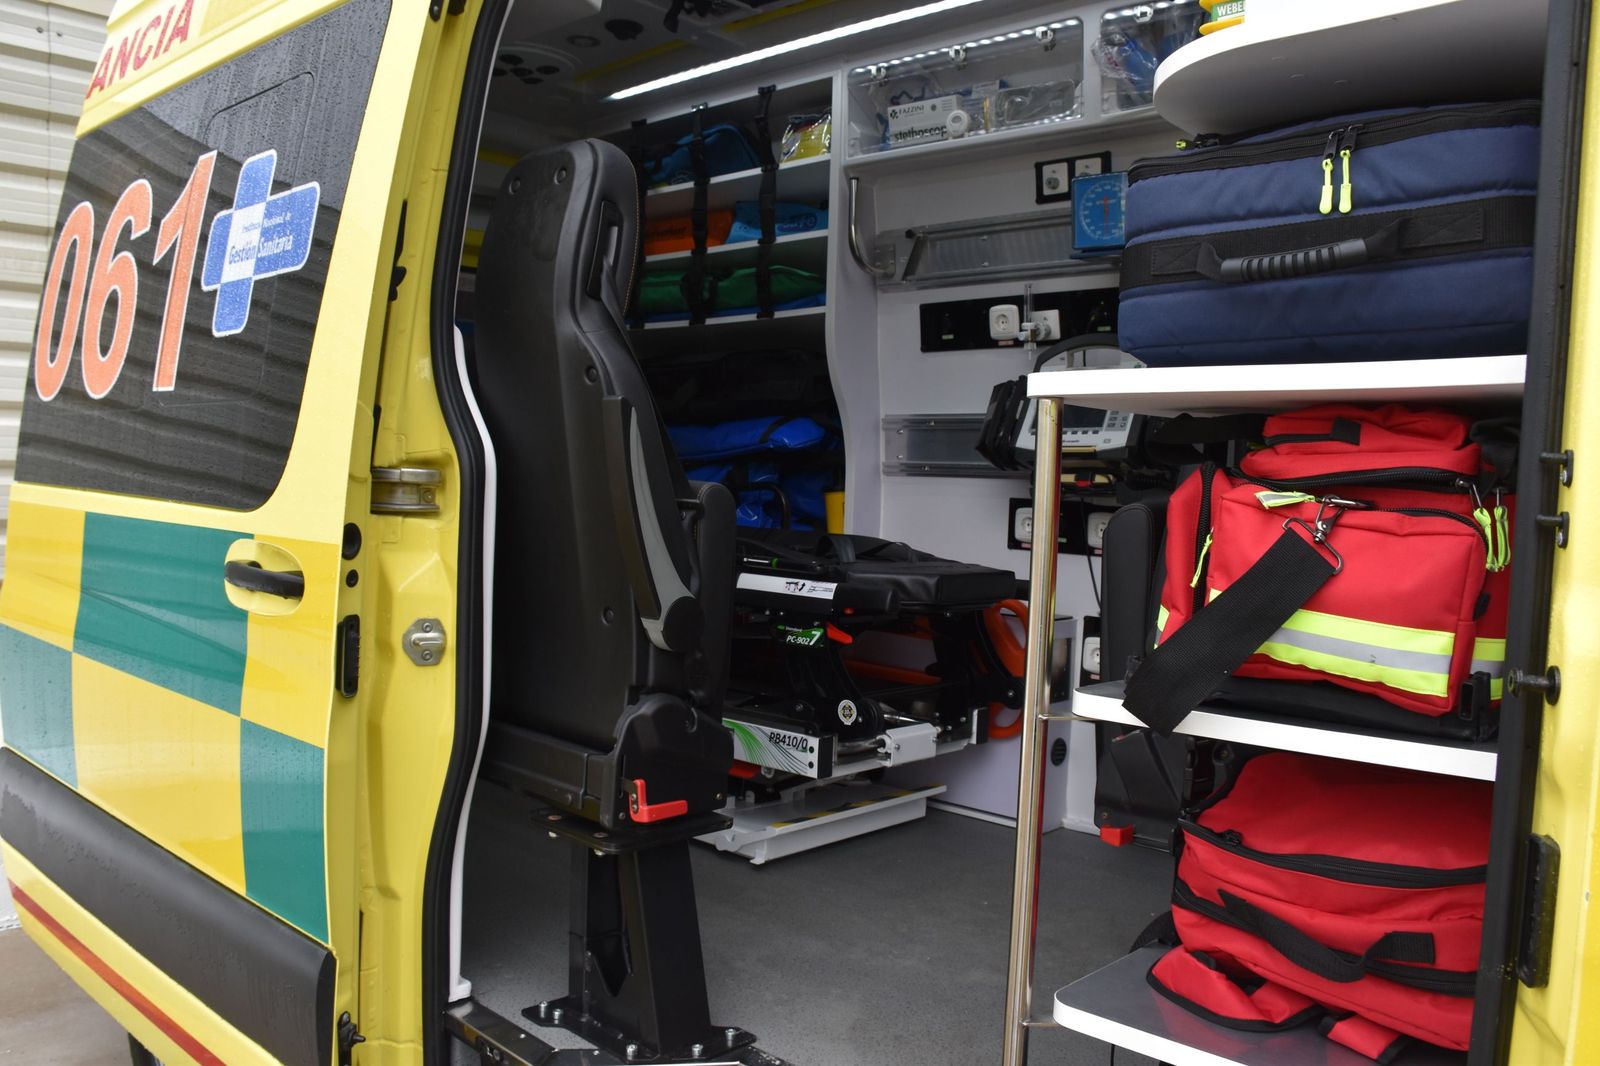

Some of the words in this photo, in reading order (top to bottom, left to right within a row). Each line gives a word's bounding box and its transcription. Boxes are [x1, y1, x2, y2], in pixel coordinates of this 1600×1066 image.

[1217, 0, 1245, 16] WEBE
[85, 0, 195, 99] ANCIA
[899, 105, 924, 114] FAZZINI
[894, 125, 947, 141] stethoscop
[228, 241, 257, 265] Gestión
[34, 150, 218, 402] 061
